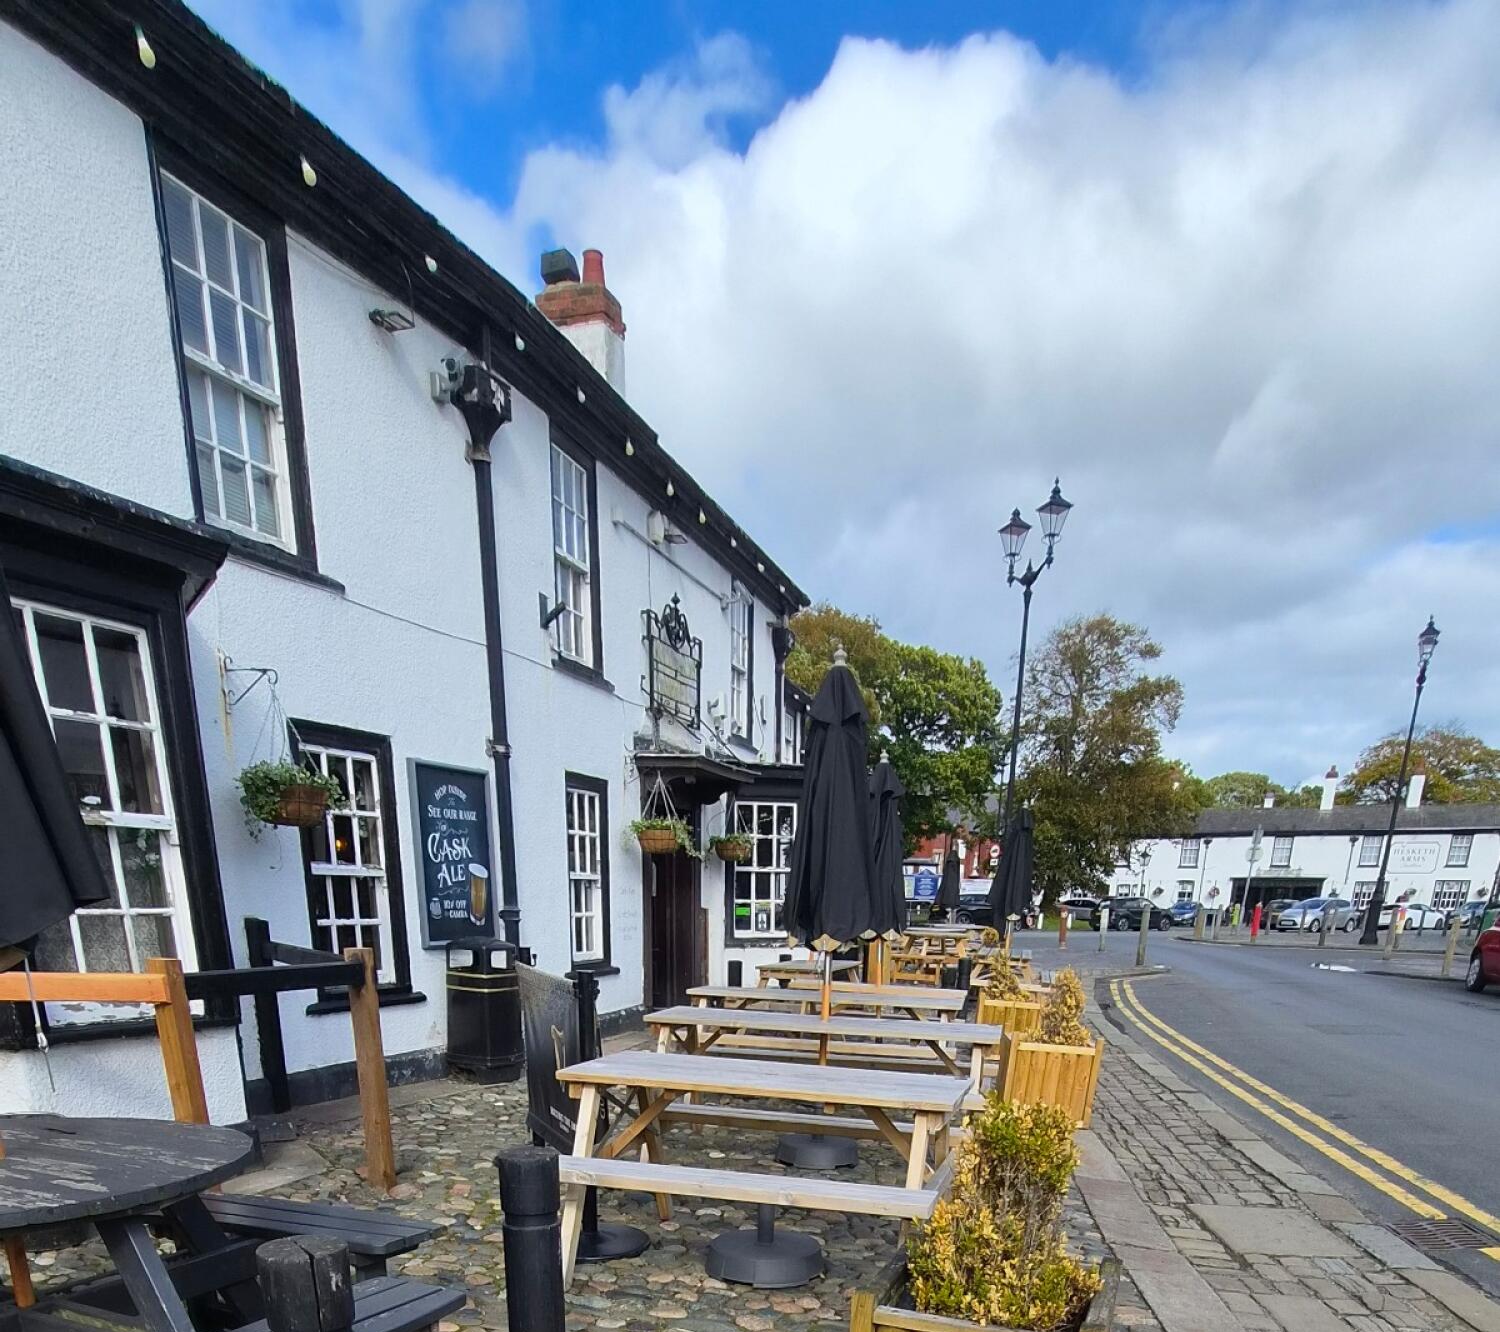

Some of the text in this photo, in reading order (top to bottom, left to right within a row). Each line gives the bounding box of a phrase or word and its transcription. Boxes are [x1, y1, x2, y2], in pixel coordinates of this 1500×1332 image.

[428, 804, 477, 820] SEE OUR RANGE
[428, 833, 472, 862] CASK
[437, 863, 466, 888] ALE
